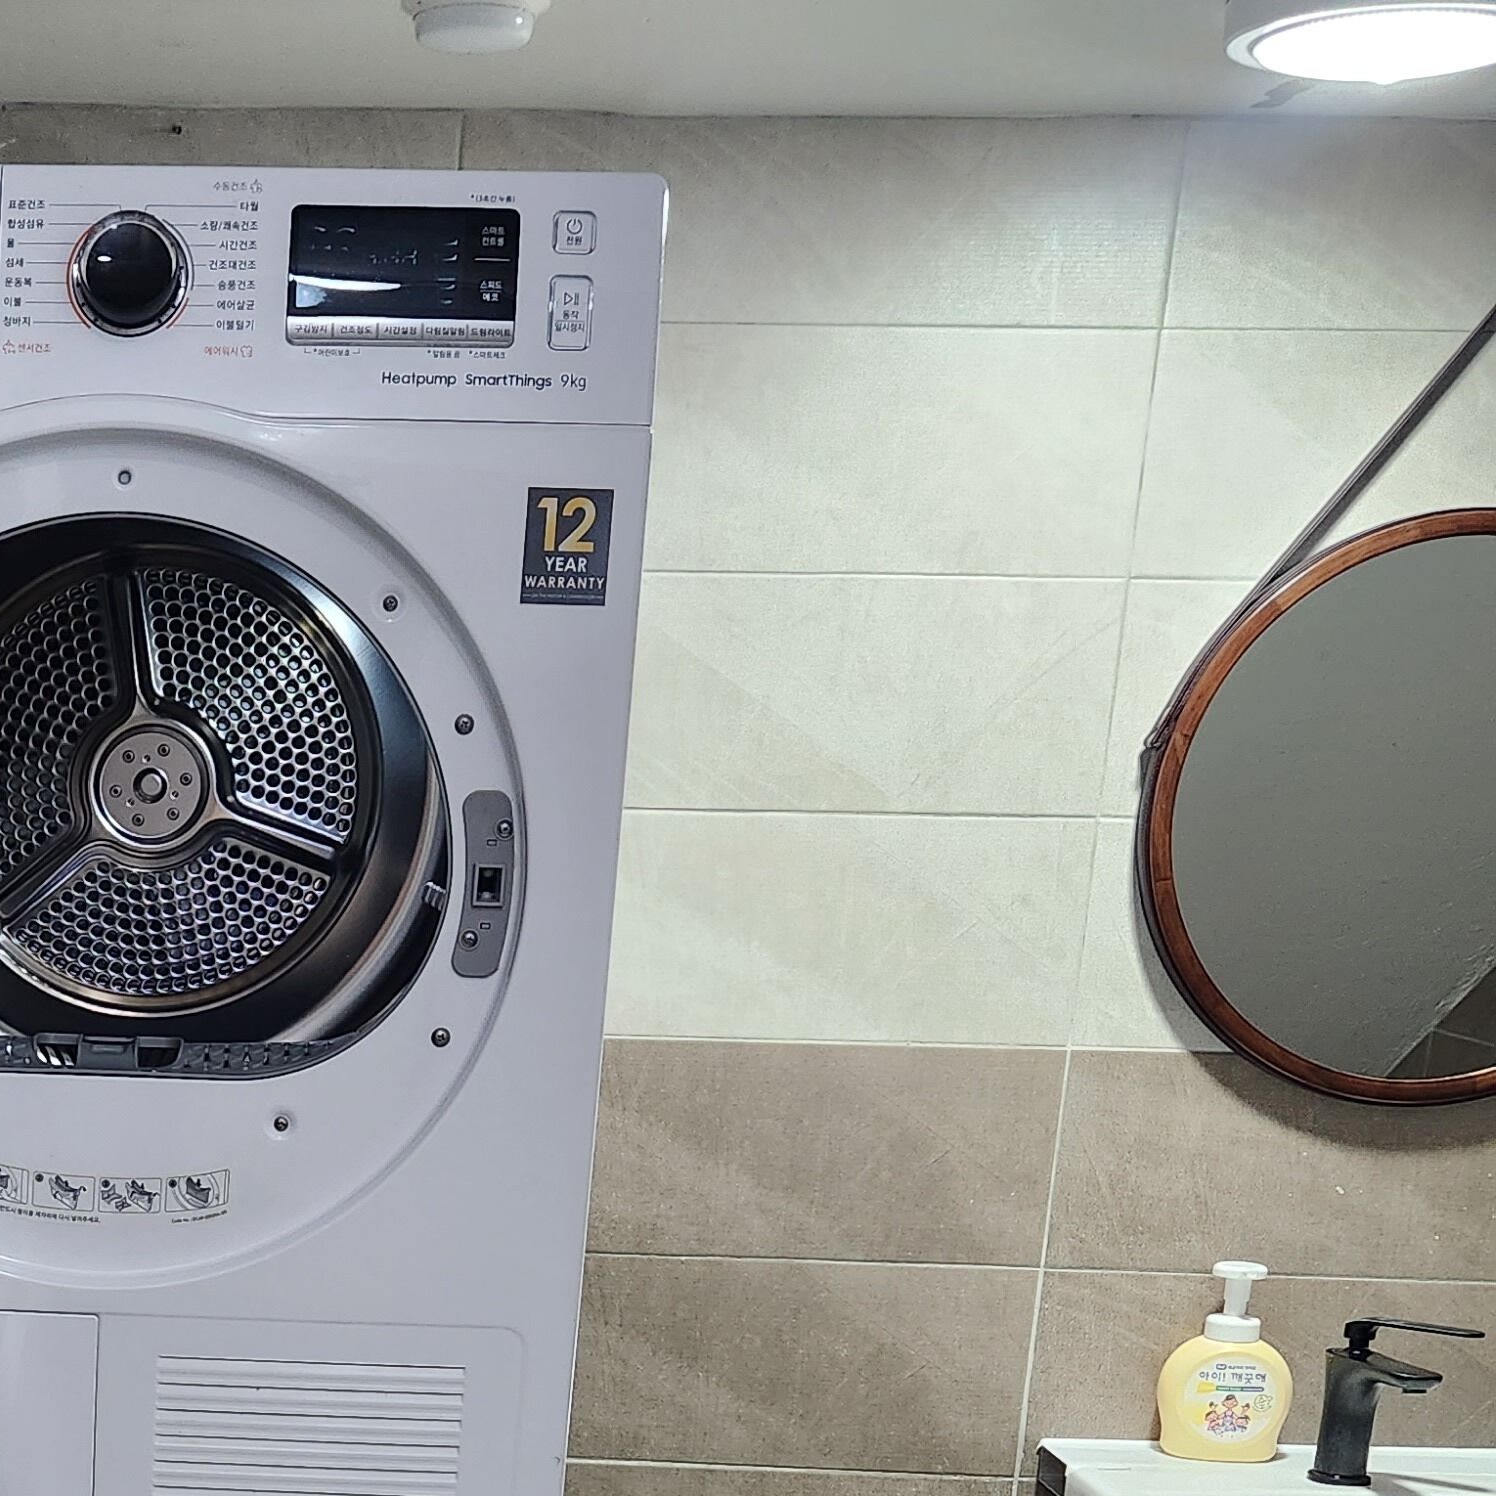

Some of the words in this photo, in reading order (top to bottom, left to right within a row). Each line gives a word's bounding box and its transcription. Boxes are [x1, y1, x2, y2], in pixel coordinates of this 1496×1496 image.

[8, 200, 46, 209] 표준건조
[240, 201, 258, 212] 타월
[7, 219, 44, 229] 합성섬유
[200, 221, 258, 231] 소량/쾌속건조
[482, 226, 505, 235] 스마트
[219, 240, 257, 250] 시간건조
[482, 237, 505, 247] 컨트롤
[566, 235, 582, 246] 전원
[5, 258, 24, 268] 섬세
[209, 260, 257, 270] 건조대건조
[5, 277, 32, 287] 운동복
[218, 280, 256, 291] 송풍건조
[480, 281, 502, 289] 스피드
[4, 297, 21, 307] 이불
[482, 293, 499, 301] 에코
[217, 300, 255, 310] 에어살균
[562, 310, 579, 319] 동작
[3, 316, 31, 327] 청바지
[216, 320, 254, 331] 이불털기
[384, 326, 417, 336] 시간설정
[555, 322, 585, 332] 일시정지
[425, 328, 465, 338] 다림질알림
[471, 329, 512, 338] 드럼라이트
[381, 371, 457, 387] Heatpump
[465, 374, 552, 390] SmartThings
[560, 375, 587, 391] 9kg
[537, 497, 596, 552] 12
[545, 556, 588, 572] YEAR
[524, 575, 605, 589] WARRANTY
